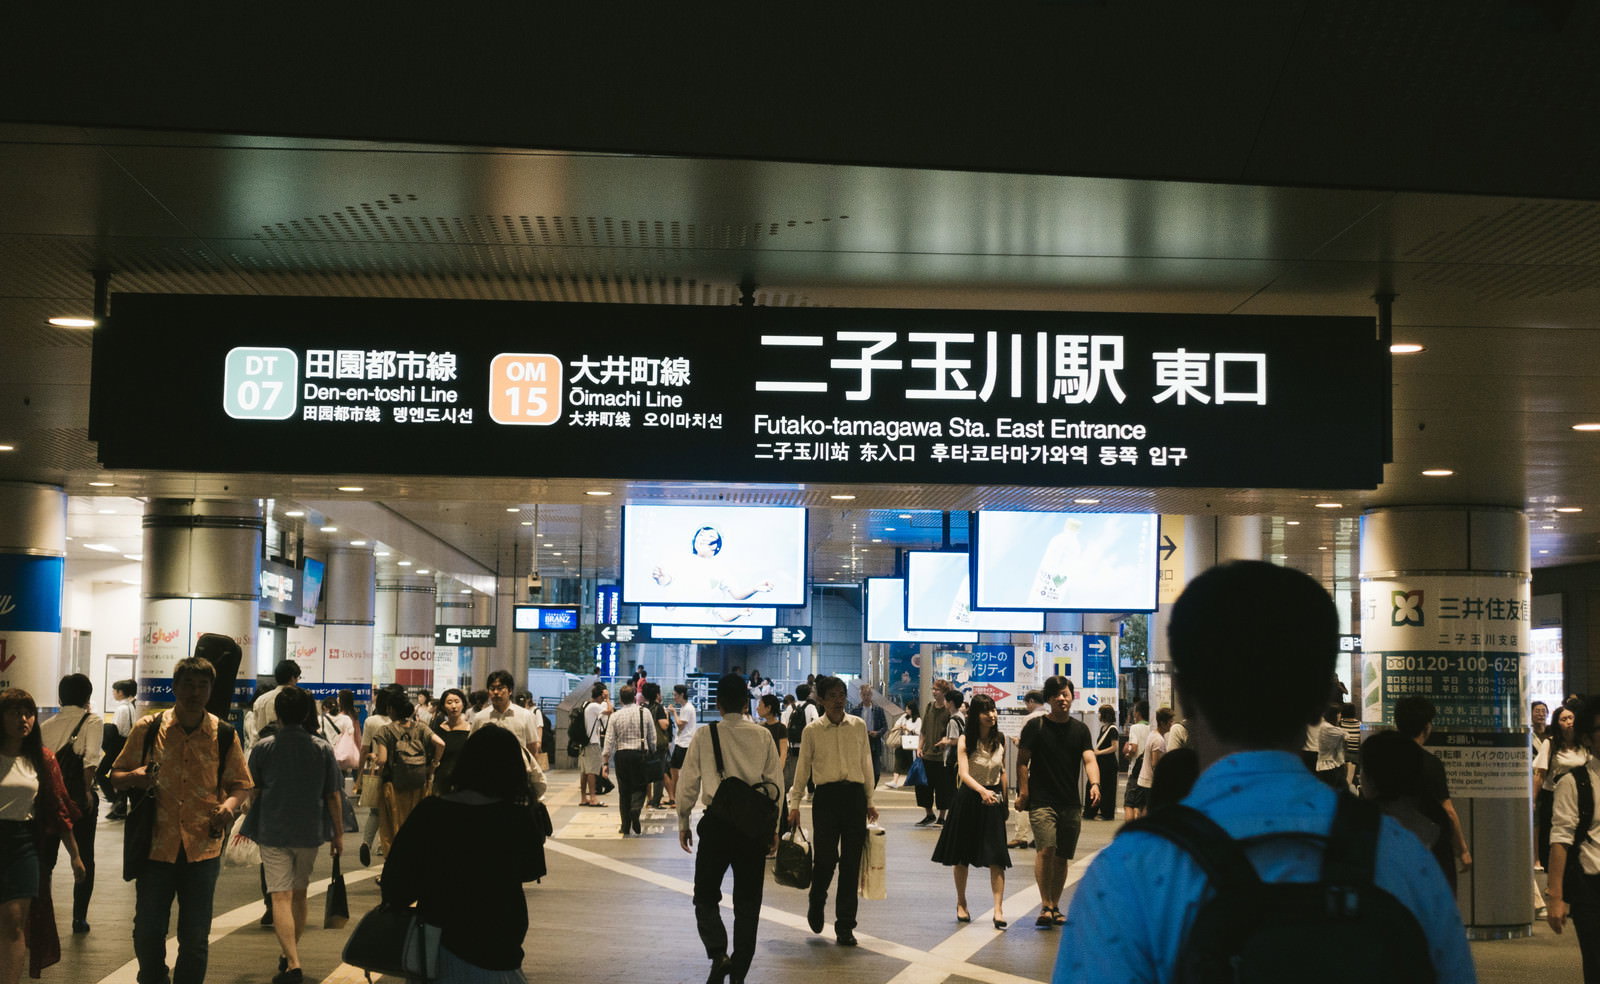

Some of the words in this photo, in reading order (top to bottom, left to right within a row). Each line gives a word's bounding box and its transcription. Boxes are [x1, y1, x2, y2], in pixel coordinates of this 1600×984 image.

[245, 355, 279, 376] DT
[305, 350, 457, 382] 田園都市線
[506, 361, 547, 382] OM
[569, 354, 691, 387] 大井町線
[755, 330, 1127, 404] 二子玉川駅
[1151, 347, 1267, 406] 東口
[237, 381, 284, 411] 07
[303, 383, 416, 402] Den-en-toshi
[420, 386, 458, 402] Line
[505, 387, 548, 417] 15
[568, 386, 641, 407] Ōimachi
[645, 391, 683, 407] Line
[303, 405, 381, 423] 田园都市线
[568, 411, 631, 428] 大井町线
[643, 413, 723, 429] 오이마치선
[754, 414, 943, 441] Futako-tamagawa
[948, 417, 991, 438] Sta.
[996, 418, 1045, 439] East
[1050, 418, 1147, 440] Entrance
[754, 442, 851, 462] 二子玉川站
[859, 442, 915, 462] 东入口
[930, 443, 1088, 465] 후타코타마가와역
[1098, 447, 1139, 466] 동쪽
[1149, 446, 1188, 467] 입구
[1438, 633, 1519, 647] 二子玉川支店
[400, 646, 434, 660] doco
[1405, 656, 1518, 673] 0120-100-625
